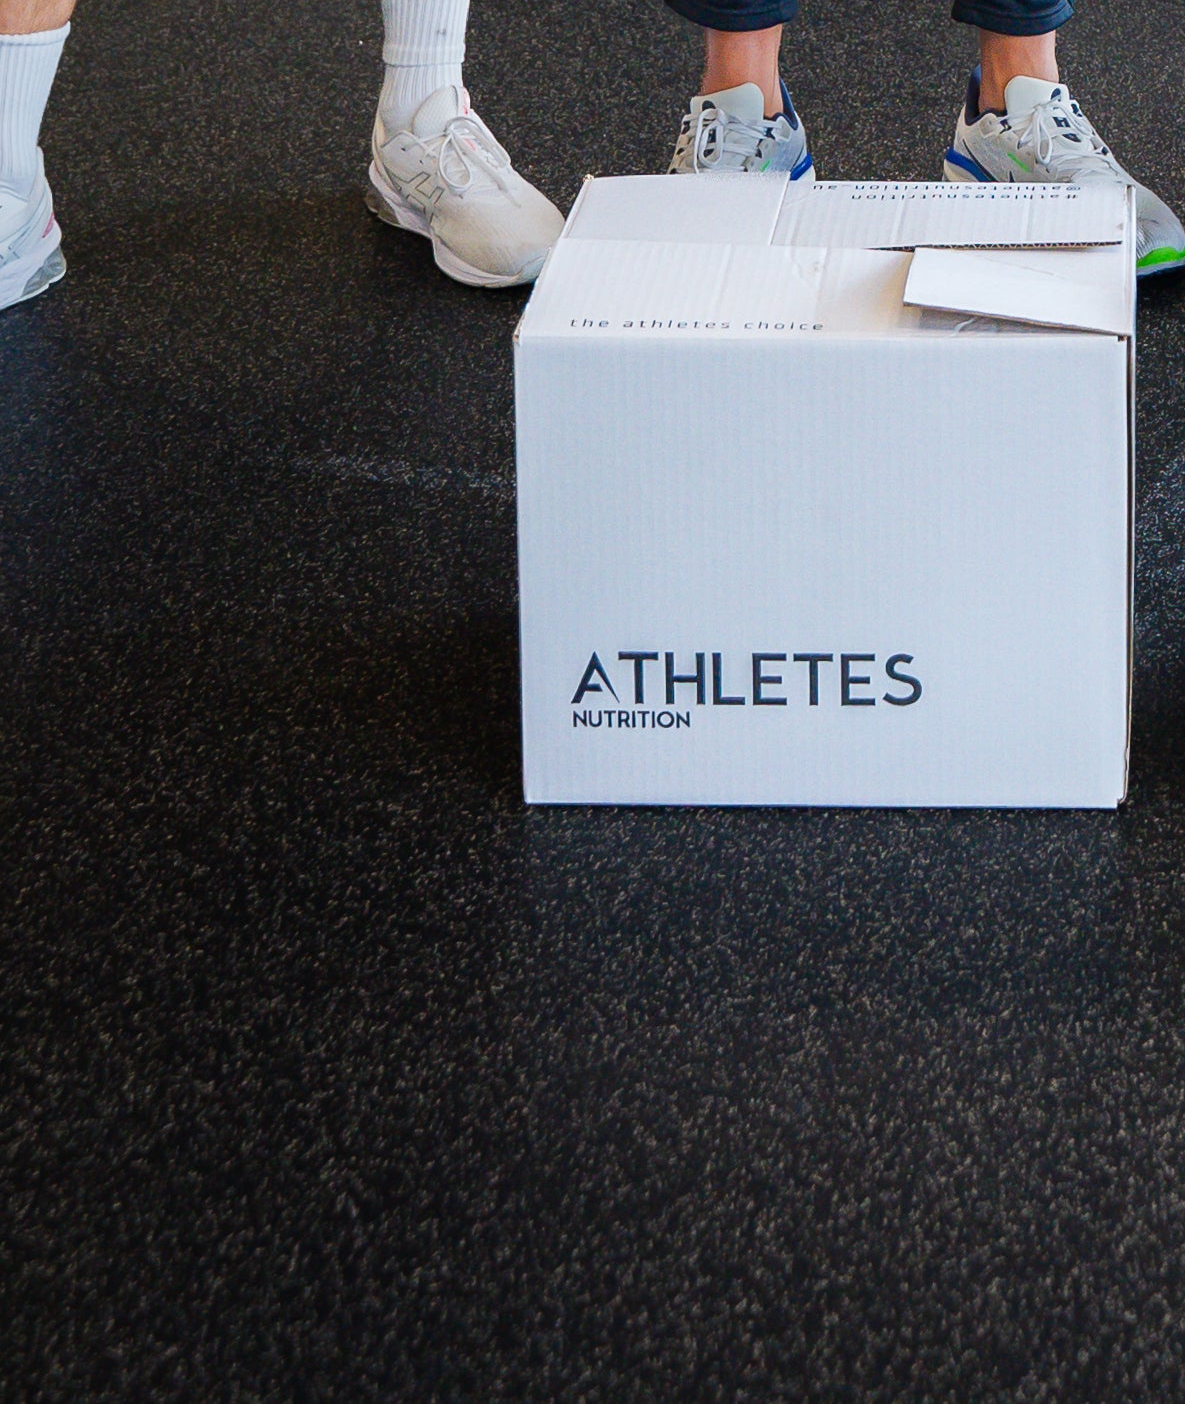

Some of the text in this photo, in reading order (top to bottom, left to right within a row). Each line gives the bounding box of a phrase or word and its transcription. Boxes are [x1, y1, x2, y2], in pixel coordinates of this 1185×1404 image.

[570, 318, 825, 331] the athletes choice
[570, 650, 923, 707] ATHLETES
[572, 709, 691, 729] NUTRITION
